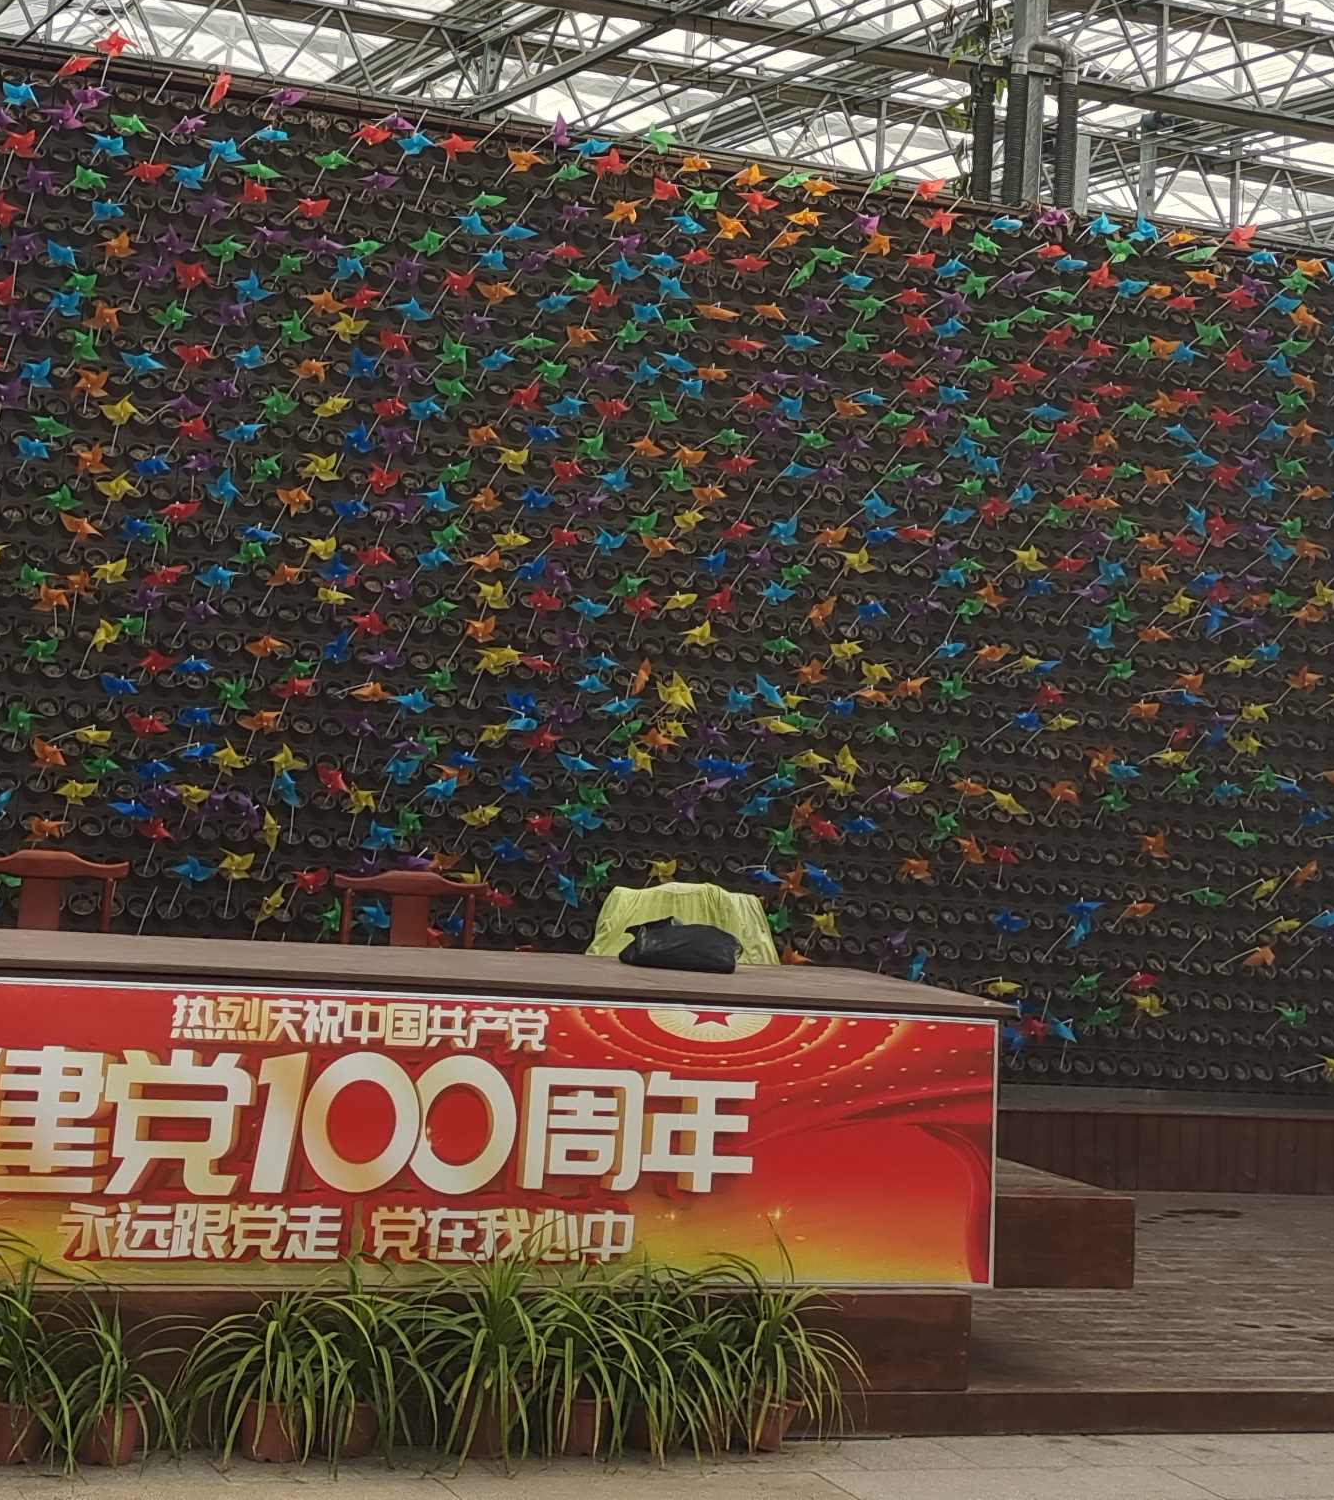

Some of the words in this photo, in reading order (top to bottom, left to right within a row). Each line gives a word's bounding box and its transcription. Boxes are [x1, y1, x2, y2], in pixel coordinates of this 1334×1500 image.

[170, 994, 550, 1052] 热烈庆祝中国共产党
[57, 1201, 342, 1261] 永远跟党走
[370, 1205, 635, 1263] 党在我心中
